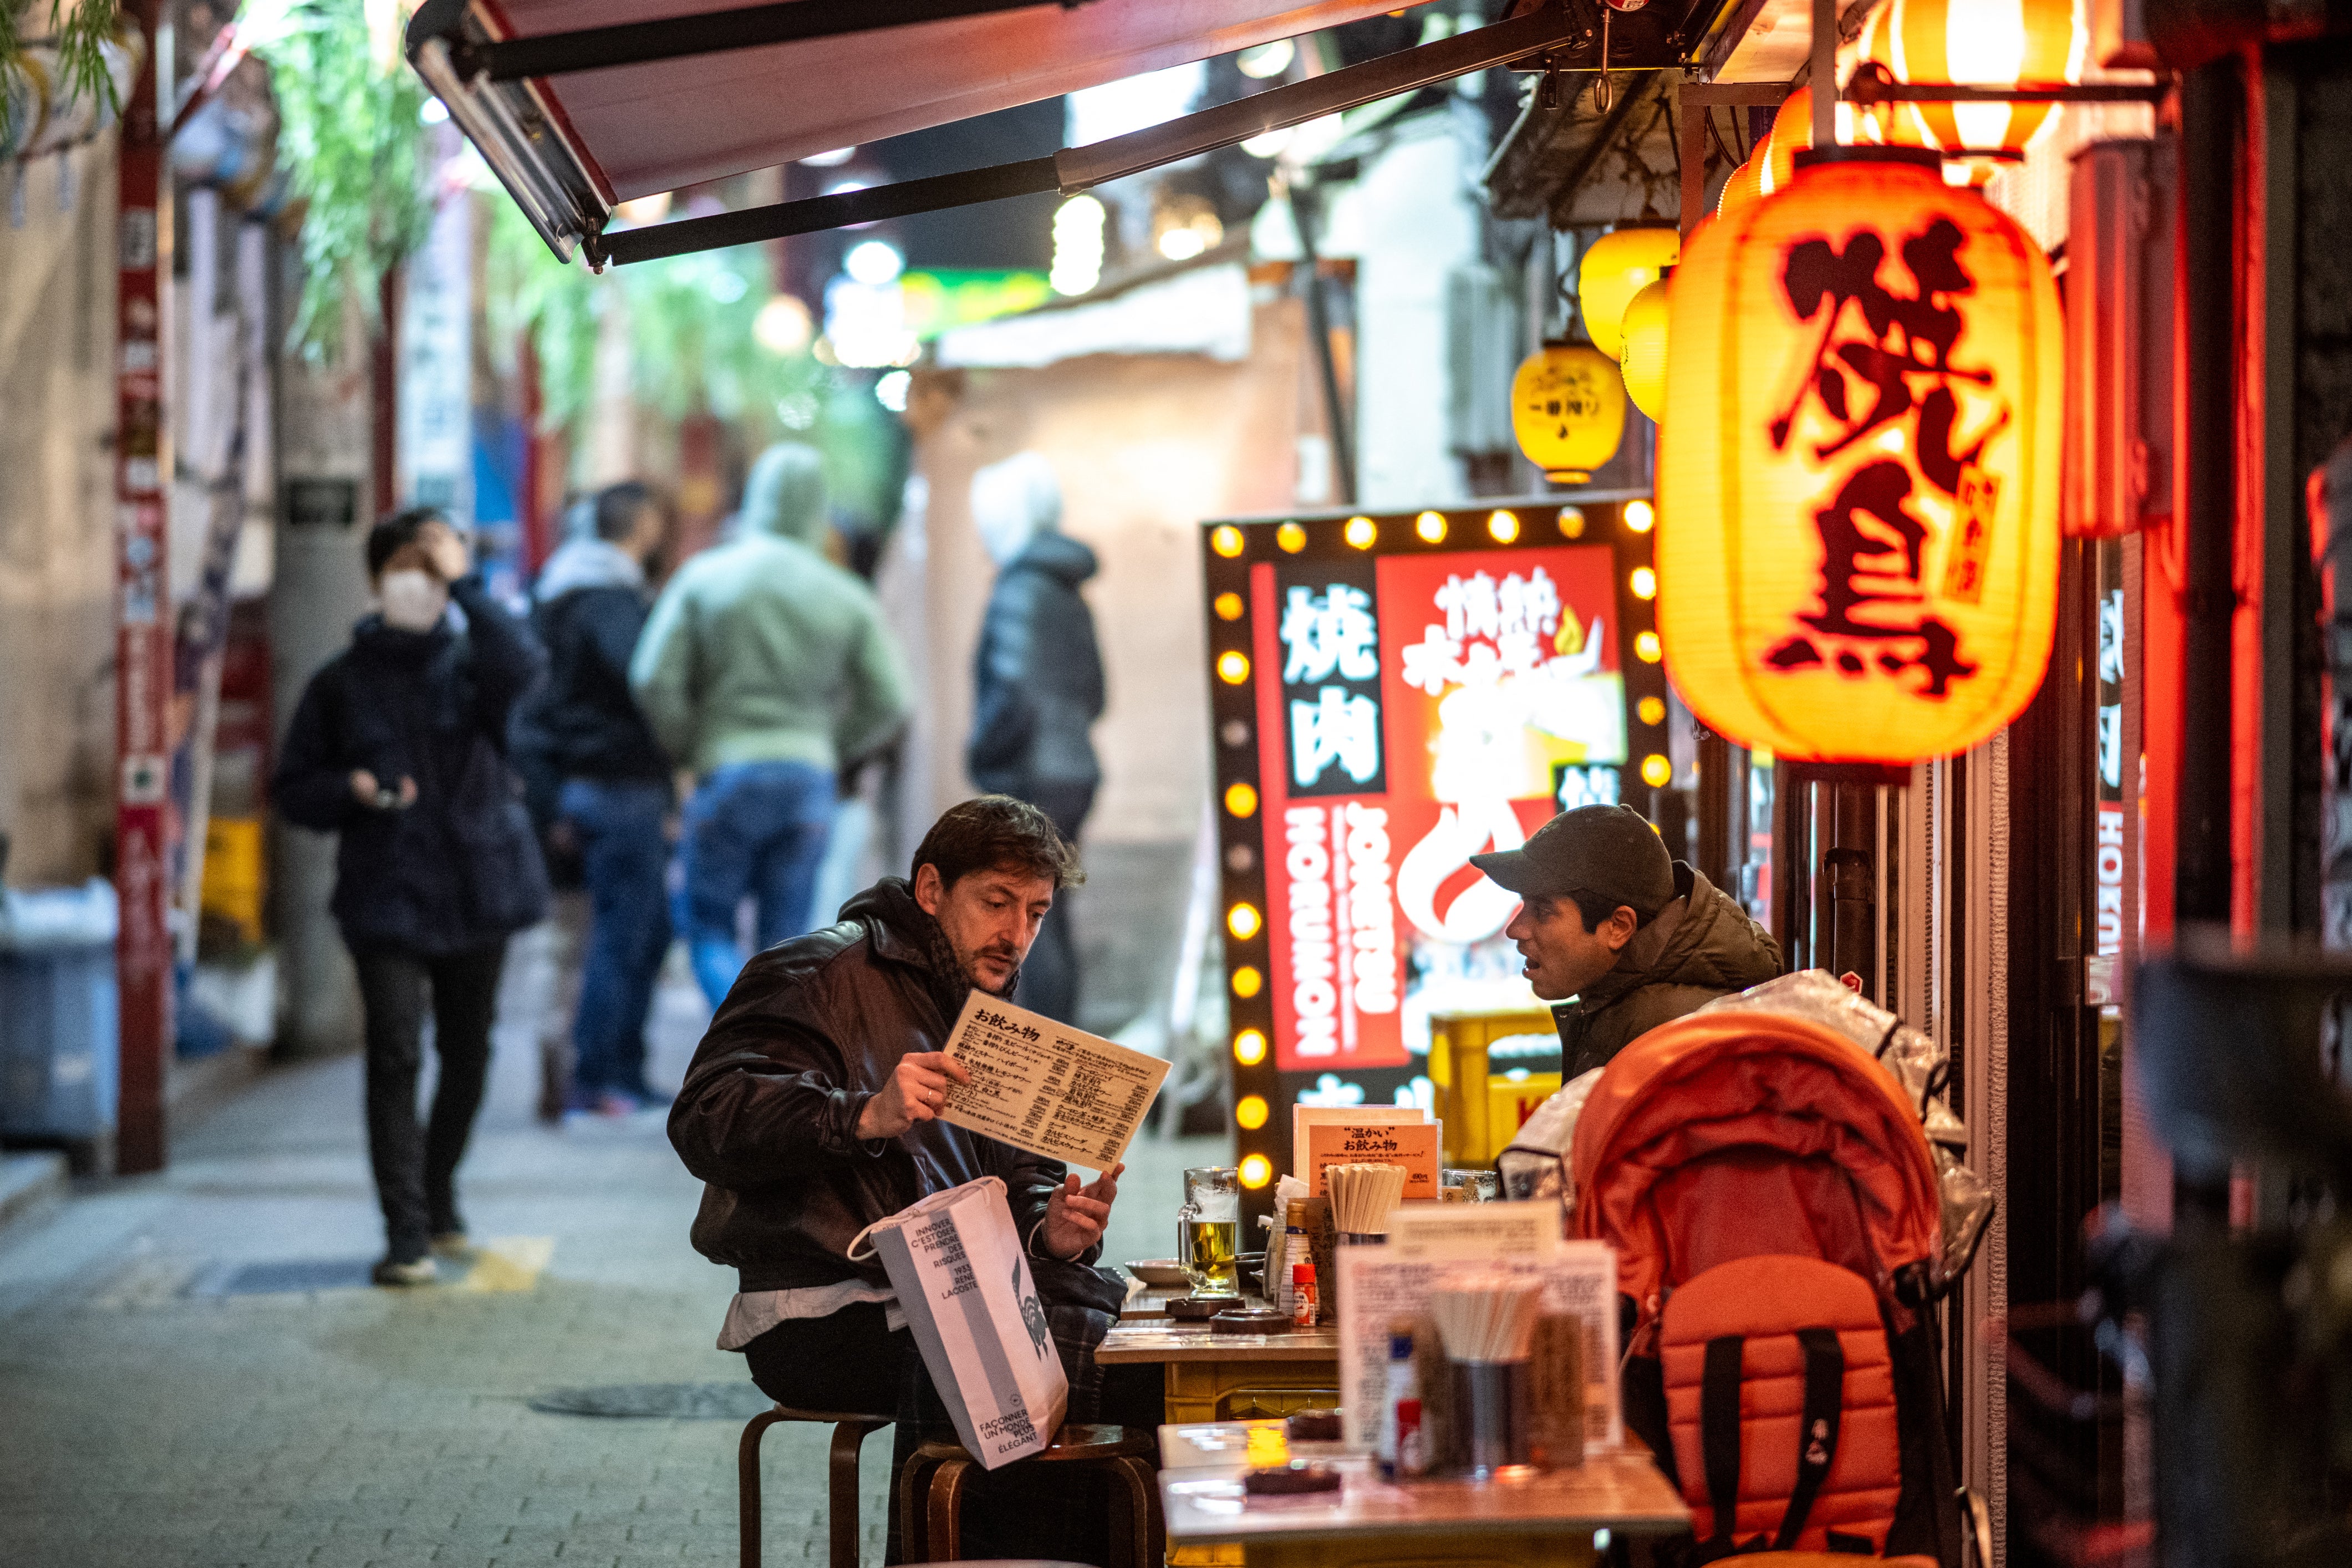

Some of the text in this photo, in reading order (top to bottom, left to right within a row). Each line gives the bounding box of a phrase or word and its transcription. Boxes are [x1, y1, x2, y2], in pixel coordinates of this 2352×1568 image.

[1280, 583, 1380, 786] 焼肉
[1284, 807, 1338, 1057] HORUMON
[974, 1009, 1040, 1041] お飲み物
[996, 1058, 1028, 1071] ハイボール
[1077, 1065, 1113, 1081] ウーロンハイ
[1071, 1081, 1112, 1096] カルピスサワー
[1046, 1127, 1087, 1143] カルピスソーダ
[1042, 1136, 1092, 1153] カルピスウォーター
[1344, 1139, 1398, 1151] お飲み物
[911, 1226, 956, 1248] C'EST OSER
[924, 1234, 960, 1253] PRENDRE
[948, 1243, 963, 1253] DES
[933, 1251, 966, 1269] RISQUES
[941, 1281, 978, 1299] LACOSTE
[979, 1409, 1028, 1432] FAÇONNER
[984, 1417, 1031, 1439] UN MONDE
[1014, 1424, 1035, 1438] PLUS
[999, 1431, 1037, 1453] ÉLÉGANT
